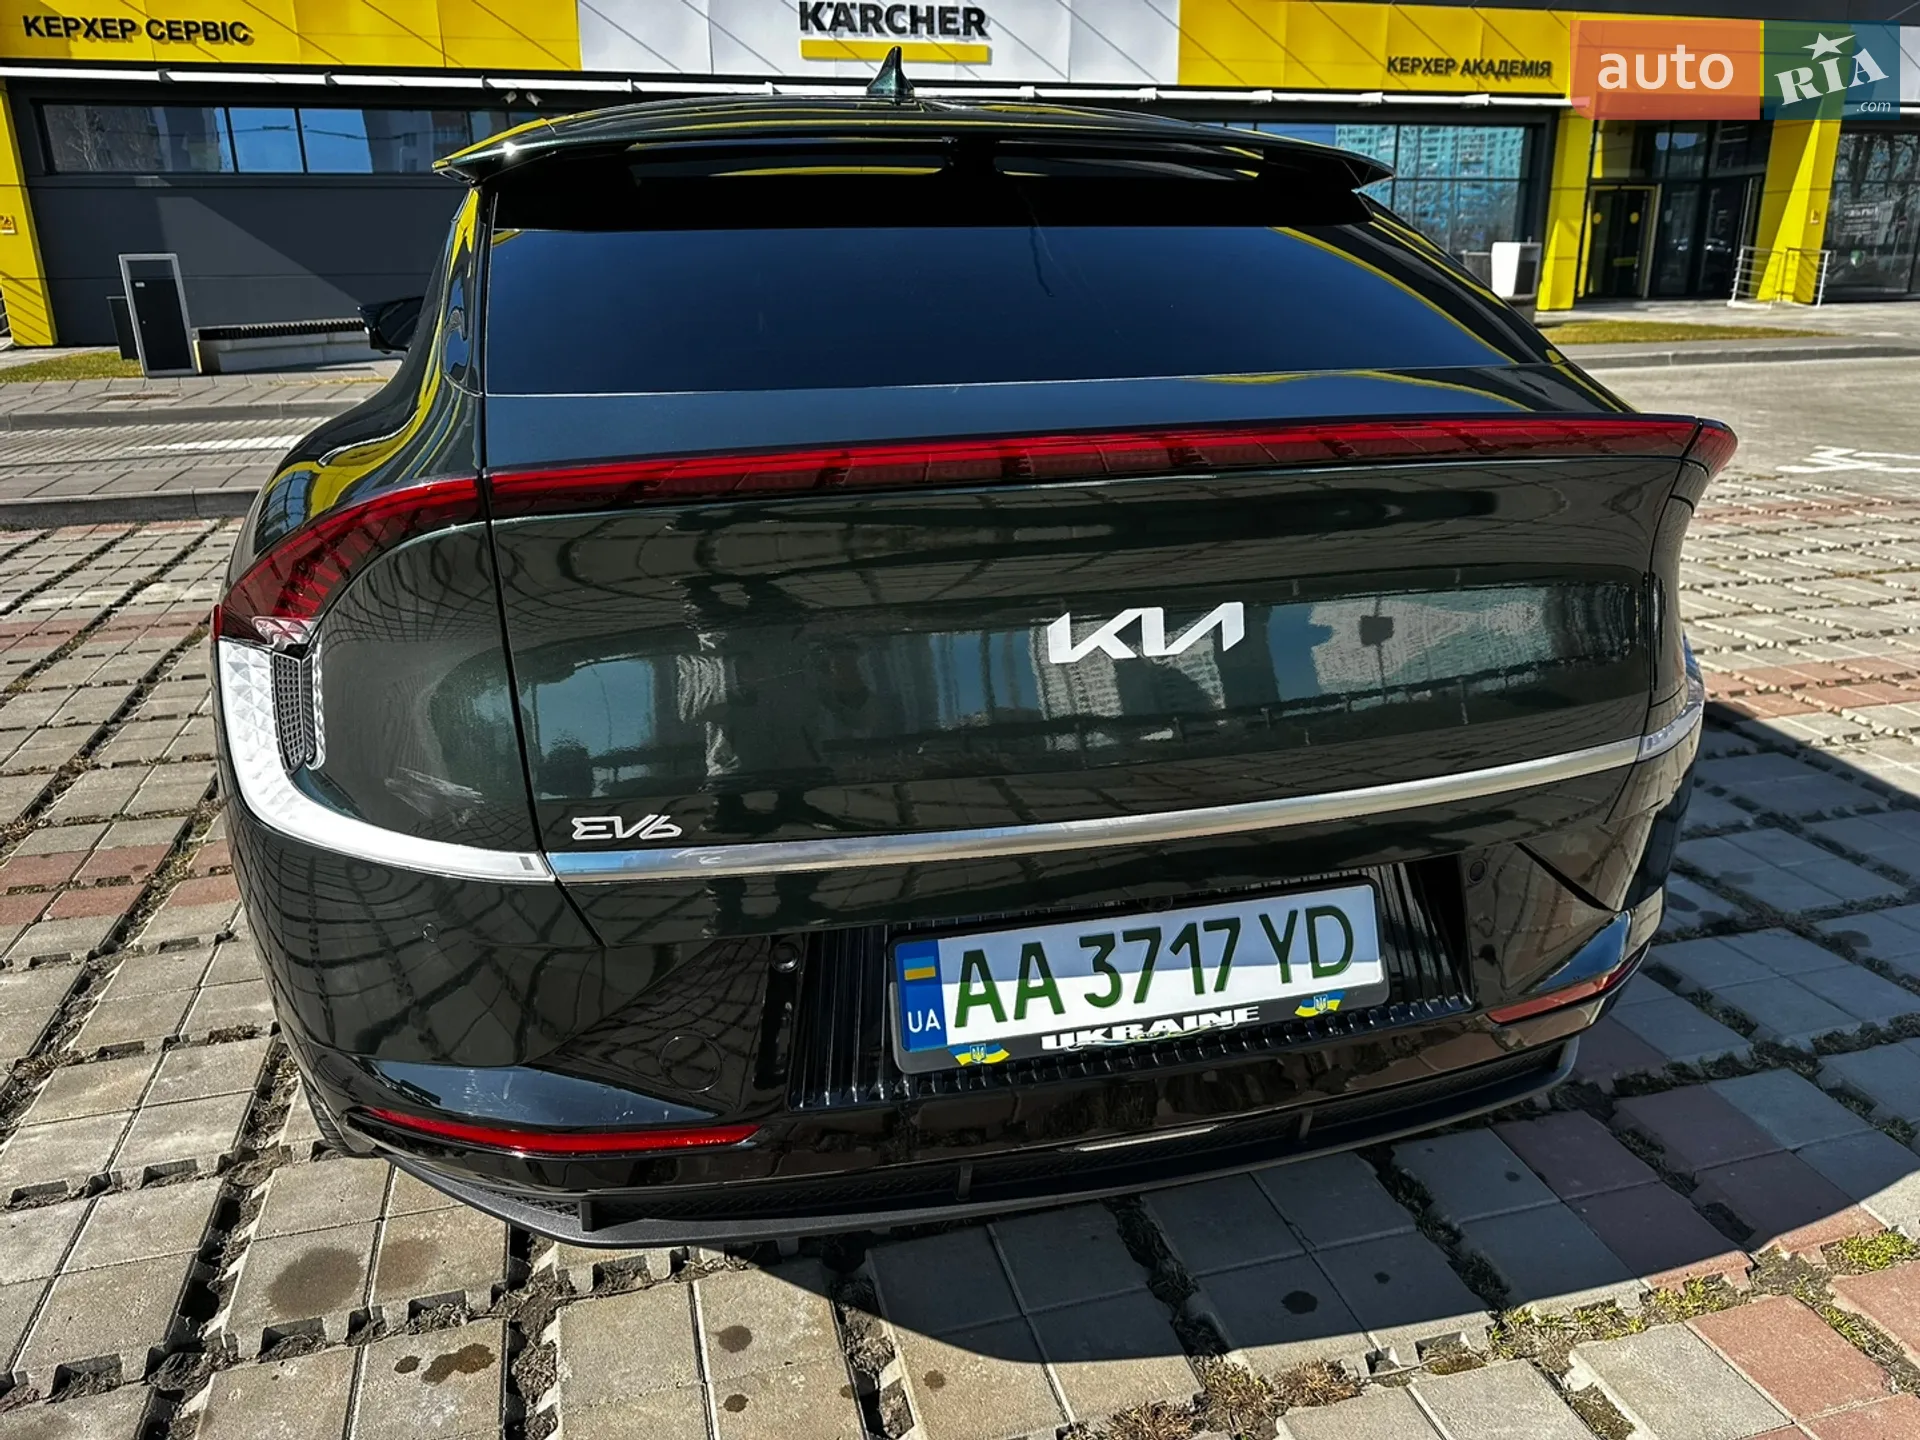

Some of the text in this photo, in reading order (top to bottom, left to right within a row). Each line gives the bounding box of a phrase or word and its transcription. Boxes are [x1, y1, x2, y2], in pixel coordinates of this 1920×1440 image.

[22, 15, 250, 43] КЕРХЕР СЕРВІС
[800, 1, 988, 37] KÄRCHER
[1386, 56, 1553, 82] КЕРХЕР АКАДЕМІЯ
[1047, 601, 1245, 664] KIA
[571, 813, 683, 840] EV6
[953, 904, 1355, 1028] AA 3717 YD
[907, 1010, 942, 1034] UA
[1041, 1005, 1260, 1050] UKRAINE
